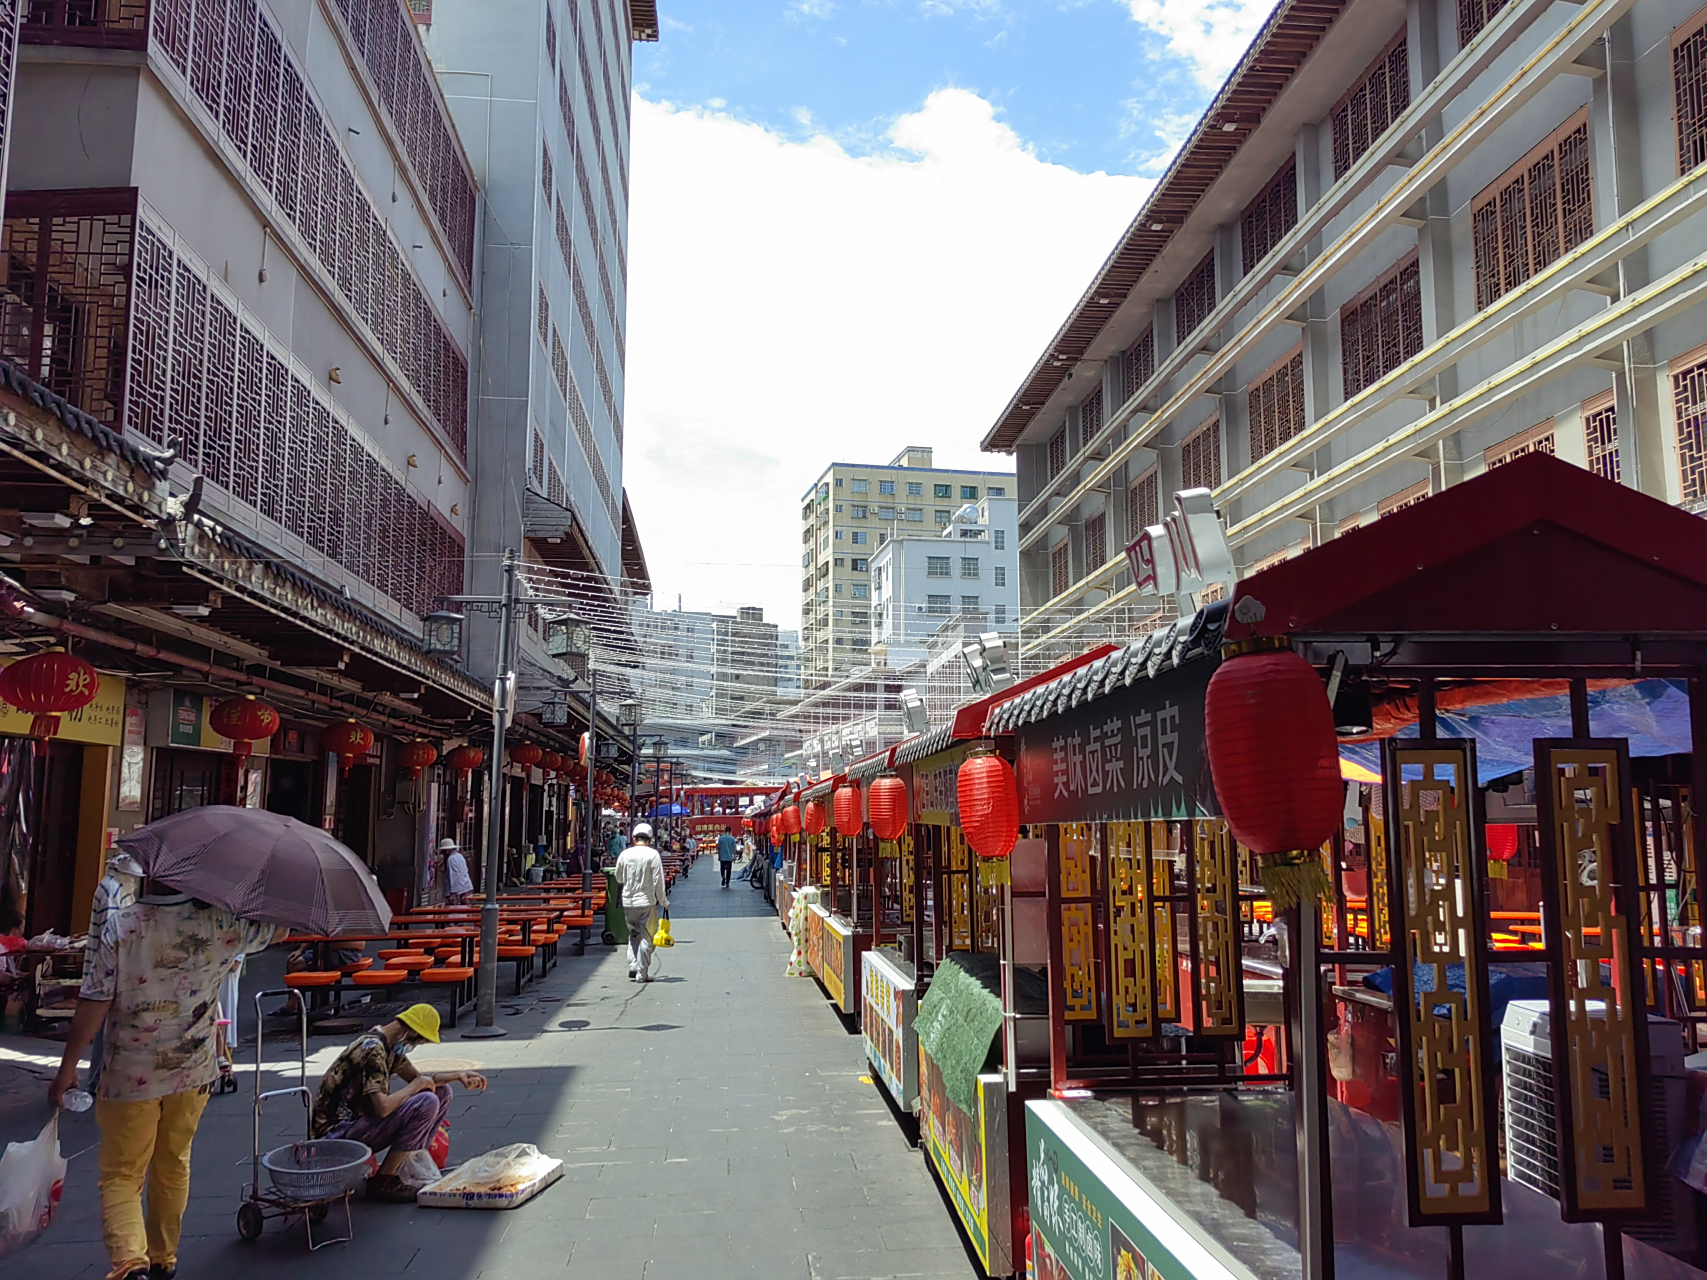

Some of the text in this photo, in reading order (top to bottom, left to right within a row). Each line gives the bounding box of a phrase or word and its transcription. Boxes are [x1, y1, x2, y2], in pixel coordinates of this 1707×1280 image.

[1125, 488, 1212, 595] 四川
[63, 666, 91, 697] 欢
[1052, 718, 1125, 799] 美味卤菜
[1130, 700, 1184, 789] 凉皮
